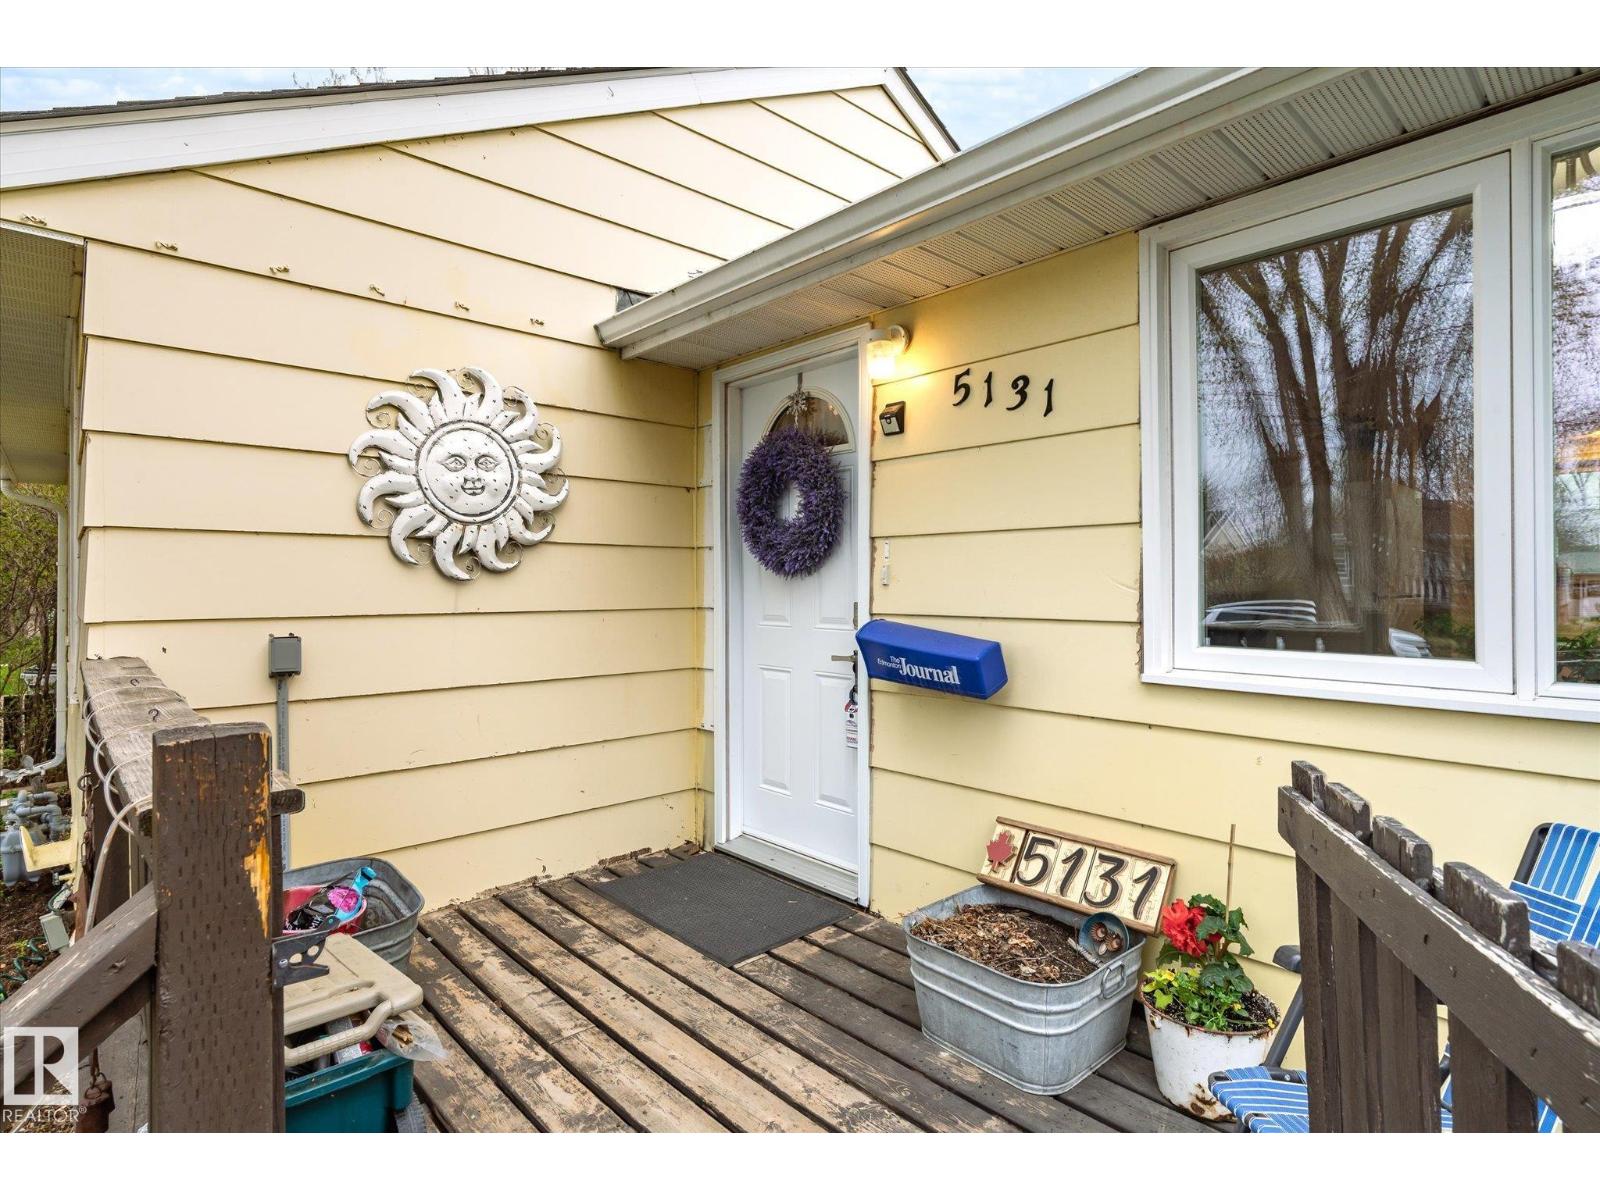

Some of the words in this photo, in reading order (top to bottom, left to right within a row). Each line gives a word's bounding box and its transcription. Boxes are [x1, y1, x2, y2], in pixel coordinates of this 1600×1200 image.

[952, 368, 1054, 418] 5131
[877, 658, 902, 669] Edmonton
[889, 656, 900, 664] The
[899, 657, 960, 685] Journal
[1016, 836, 1161, 920] 5131
